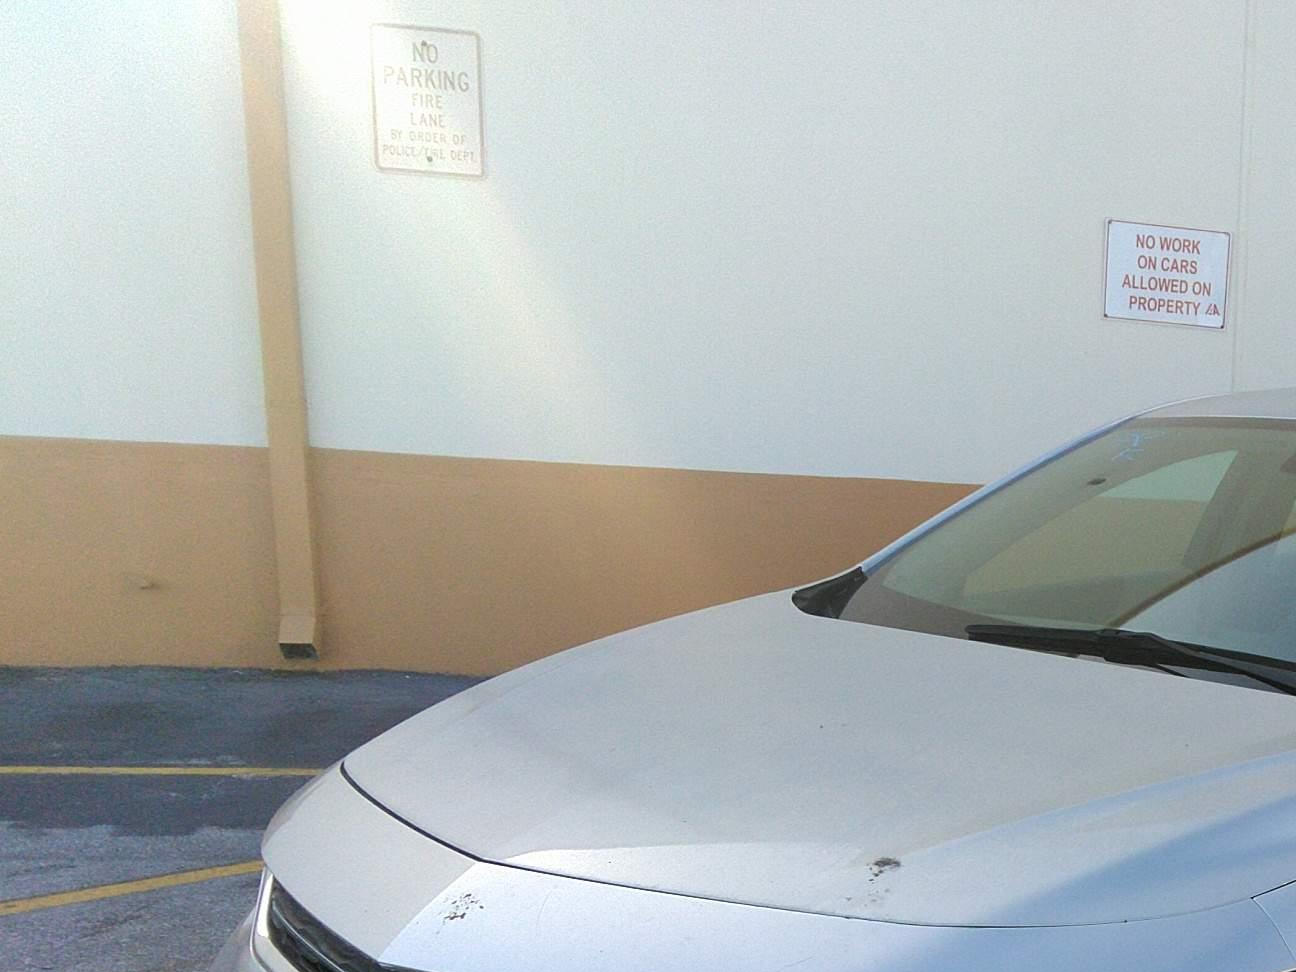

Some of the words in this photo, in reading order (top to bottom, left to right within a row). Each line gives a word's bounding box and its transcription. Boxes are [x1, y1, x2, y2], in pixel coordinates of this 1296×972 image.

[412, 42, 438, 63] NO
[383, 65, 470, 92] PARKING
[411, 92, 443, 109] FIRE
[410, 112, 446, 128] LANE
[390, 129, 403, 141] BY
[409, 130, 447, 144] ORDER
[452, 134, 467, 145] OF
[1136, 234, 1155, 249] NO
[1160, 236, 1200, 254] WORK
[1137, 255, 1157, 270] ON
[1161, 257, 1198, 274] CARS
[1122, 274, 1188, 294] ALLOWED
[1192, 281, 1211, 296] ON
[1129, 295, 1200, 316] PROPERTY
